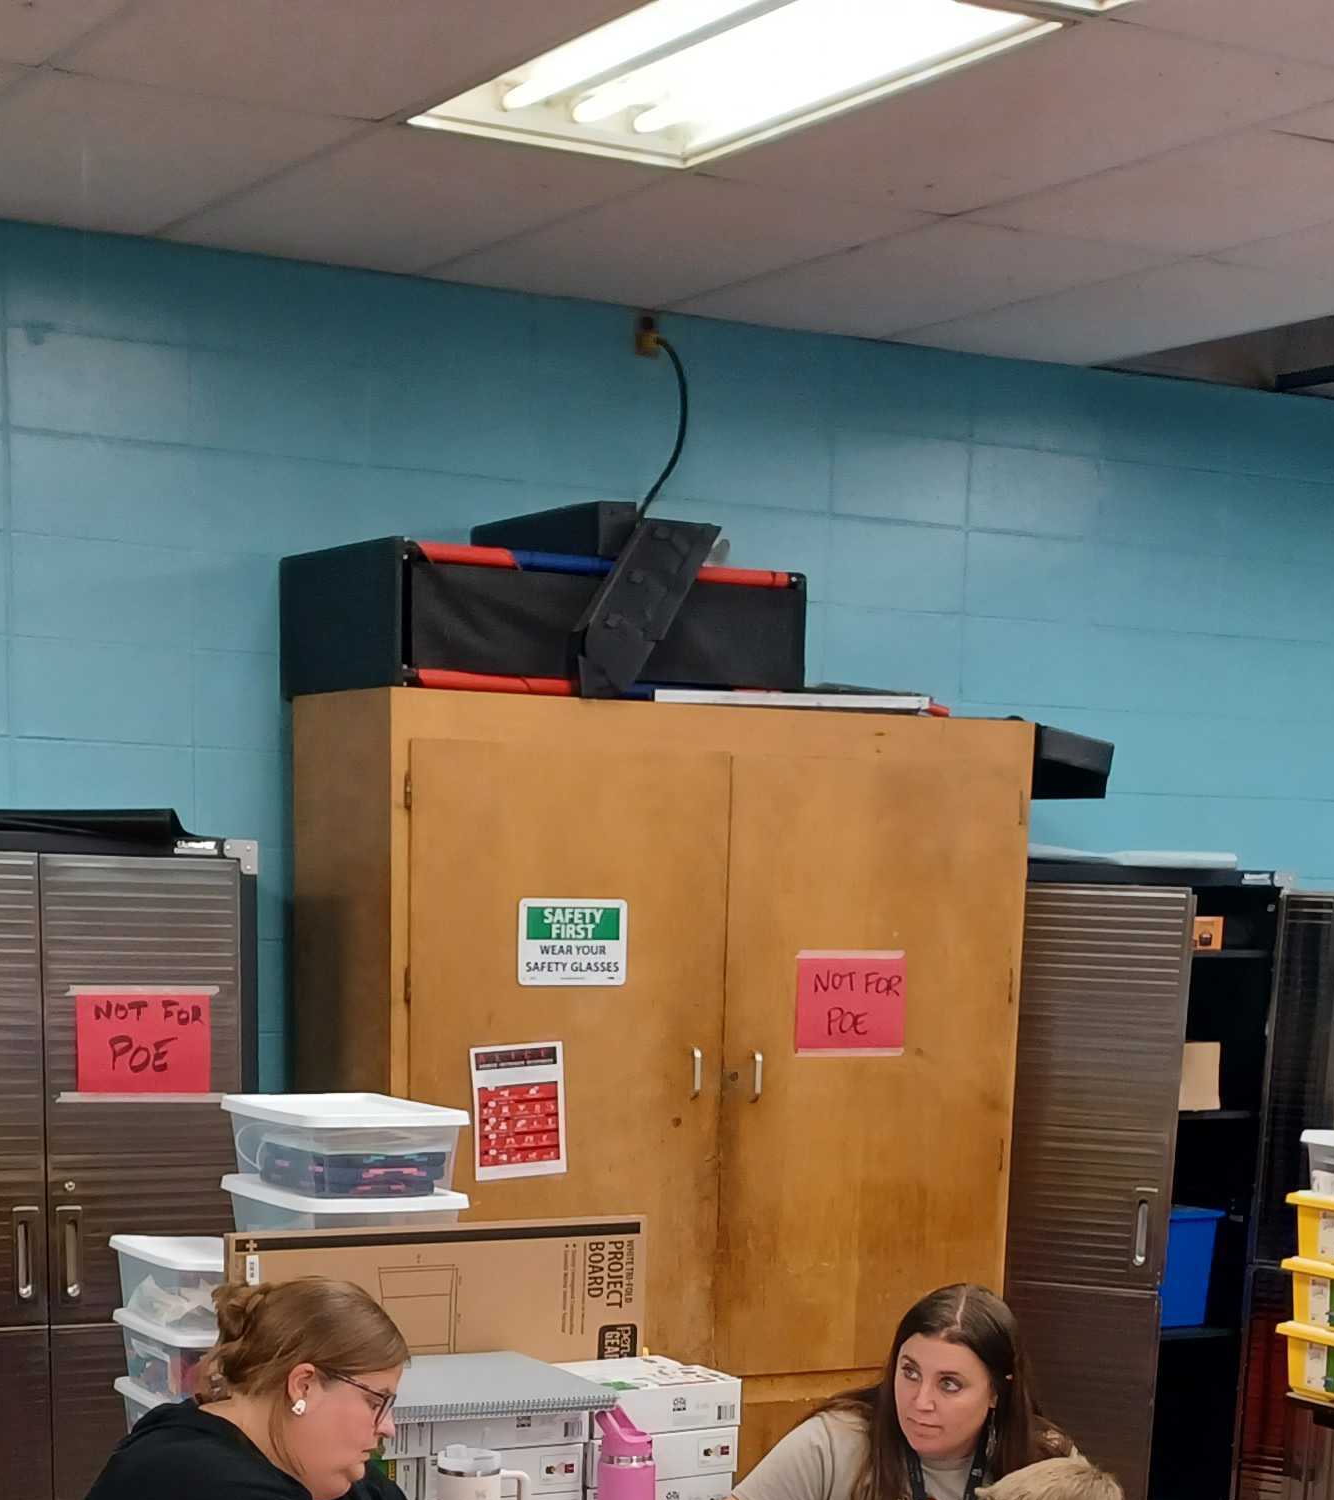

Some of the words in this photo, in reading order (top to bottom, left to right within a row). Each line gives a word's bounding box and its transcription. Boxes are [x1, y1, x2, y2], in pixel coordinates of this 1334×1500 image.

[543, 908, 604, 924] SAFETY
[551, 923, 596, 939] FIRST
[539, 944, 573, 956] WEAR
[575, 944, 607, 956] YOUR
[525, 961, 568, 973] SAFETY
[570, 961, 620, 973] GLASSES
[813, 970, 857, 993] NOT
[864, 971, 903, 997] FOR
[93, 999, 149, 1021] NOT
[161, 1000, 205, 1026] FOR
[827, 1006, 869, 1037] POE
[108, 1034, 179, 1074] POE
[587, 1241, 605, 1298] BOARD
[605, 1240, 625, 1309] PROJECT
